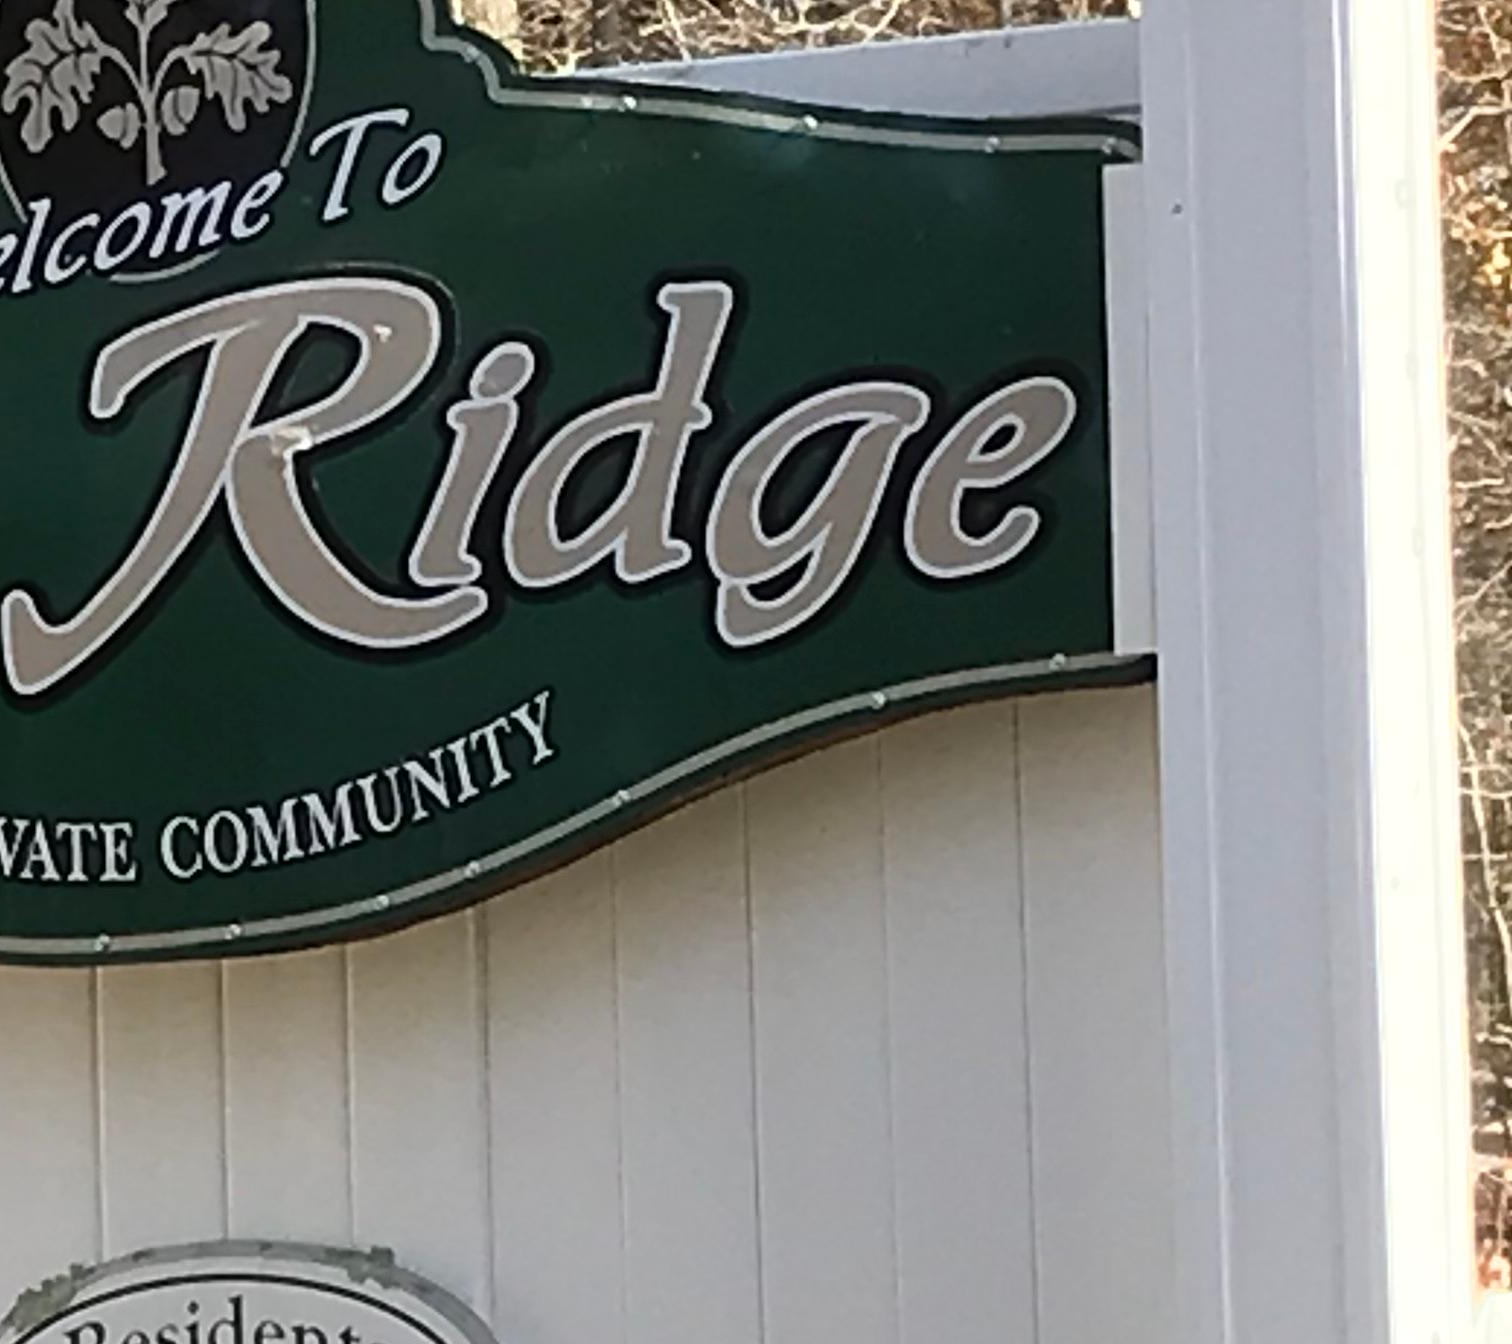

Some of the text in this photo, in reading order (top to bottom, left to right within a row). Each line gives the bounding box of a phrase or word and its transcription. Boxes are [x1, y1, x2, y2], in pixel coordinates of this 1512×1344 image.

[310, 108, 443, 223] To
[2, 274, 1079, 697] Ridge
[158, 691, 555, 880] COMMUNITY
